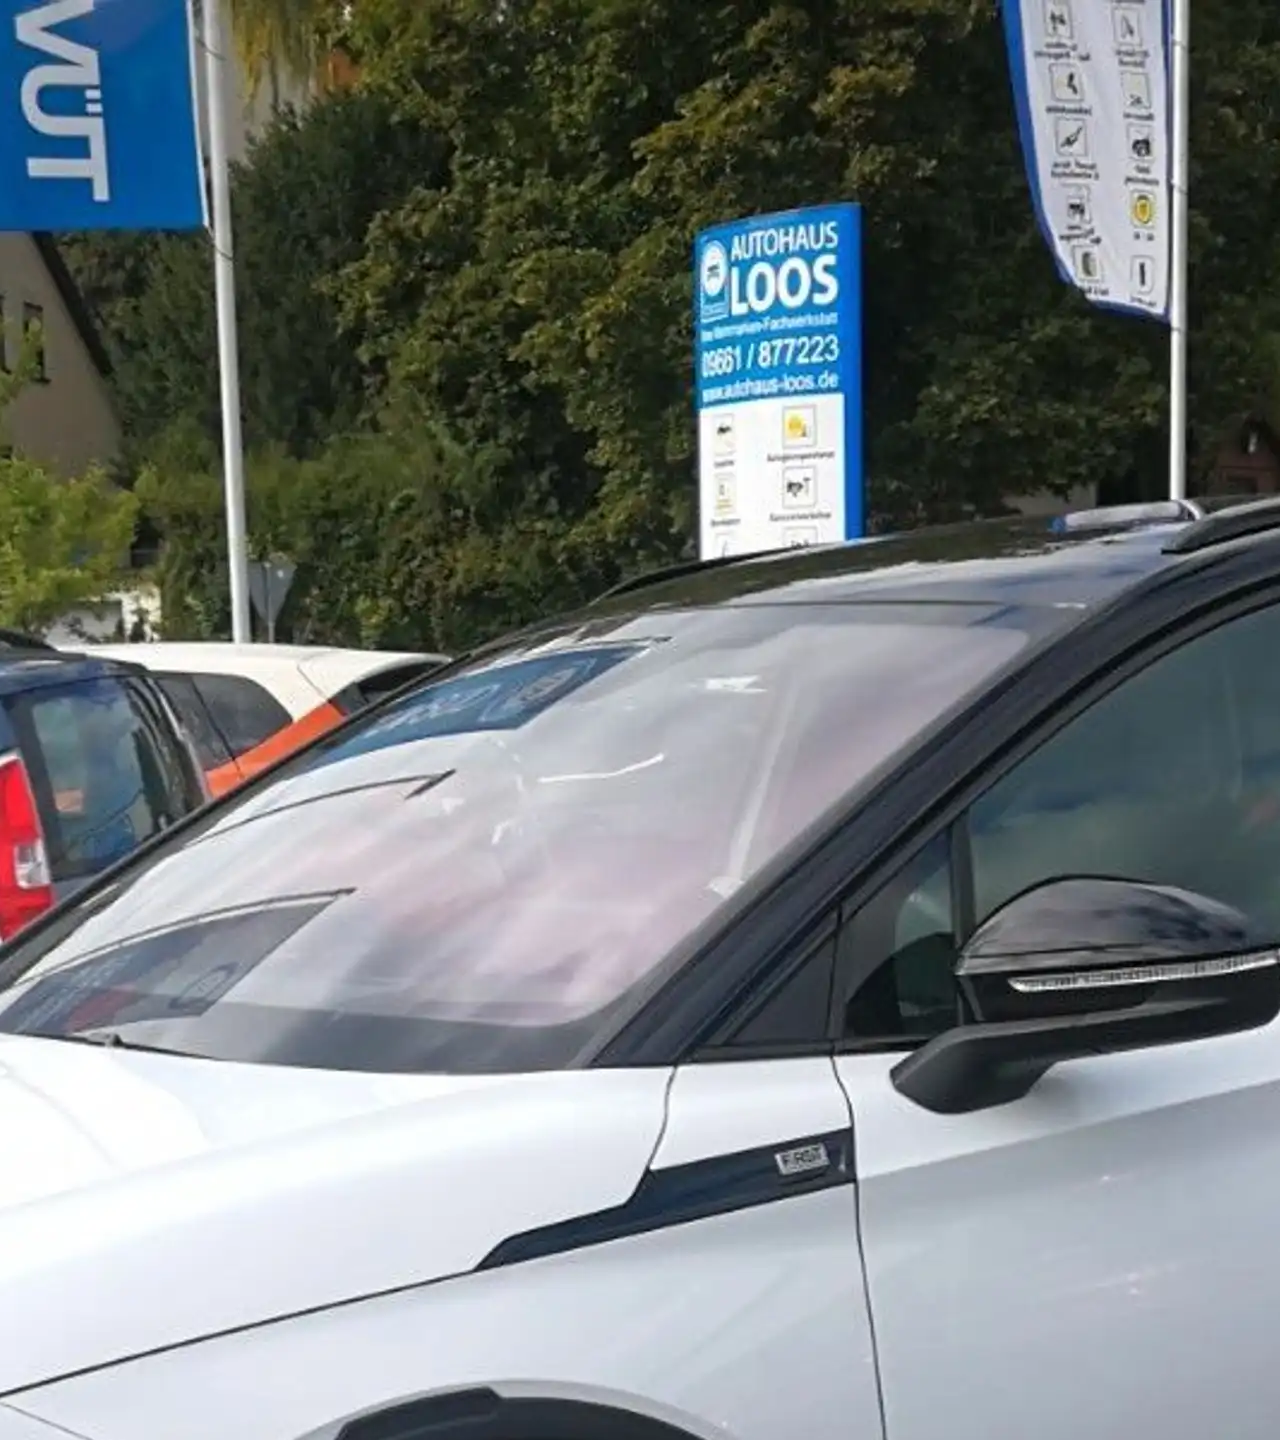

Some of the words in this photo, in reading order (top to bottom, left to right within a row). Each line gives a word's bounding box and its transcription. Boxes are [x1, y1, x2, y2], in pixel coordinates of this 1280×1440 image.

[730, 220, 838, 259] AUTOHAUS
[730, 256, 839, 316] LOOS
[757, 333, 840, 369] 877223
